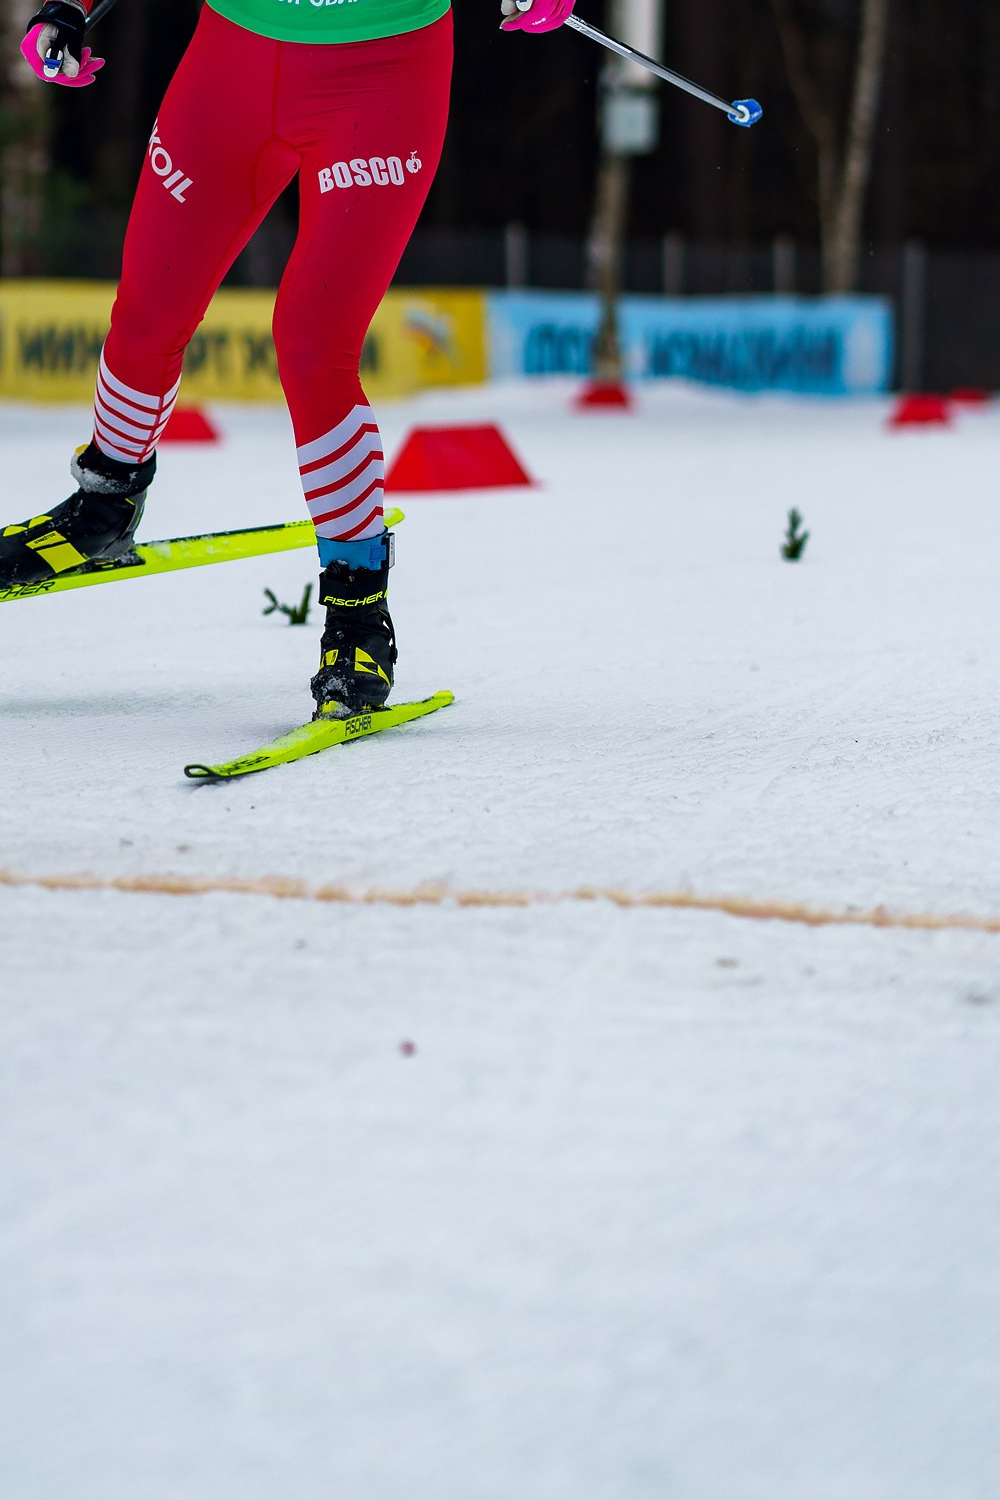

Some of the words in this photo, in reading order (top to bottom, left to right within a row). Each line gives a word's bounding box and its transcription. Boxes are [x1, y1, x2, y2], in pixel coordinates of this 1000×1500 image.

[317, 156, 406, 195] BOSCO
[323, 586, 384, 608] FISCHER
[344, 714, 373, 737] FISCHER
